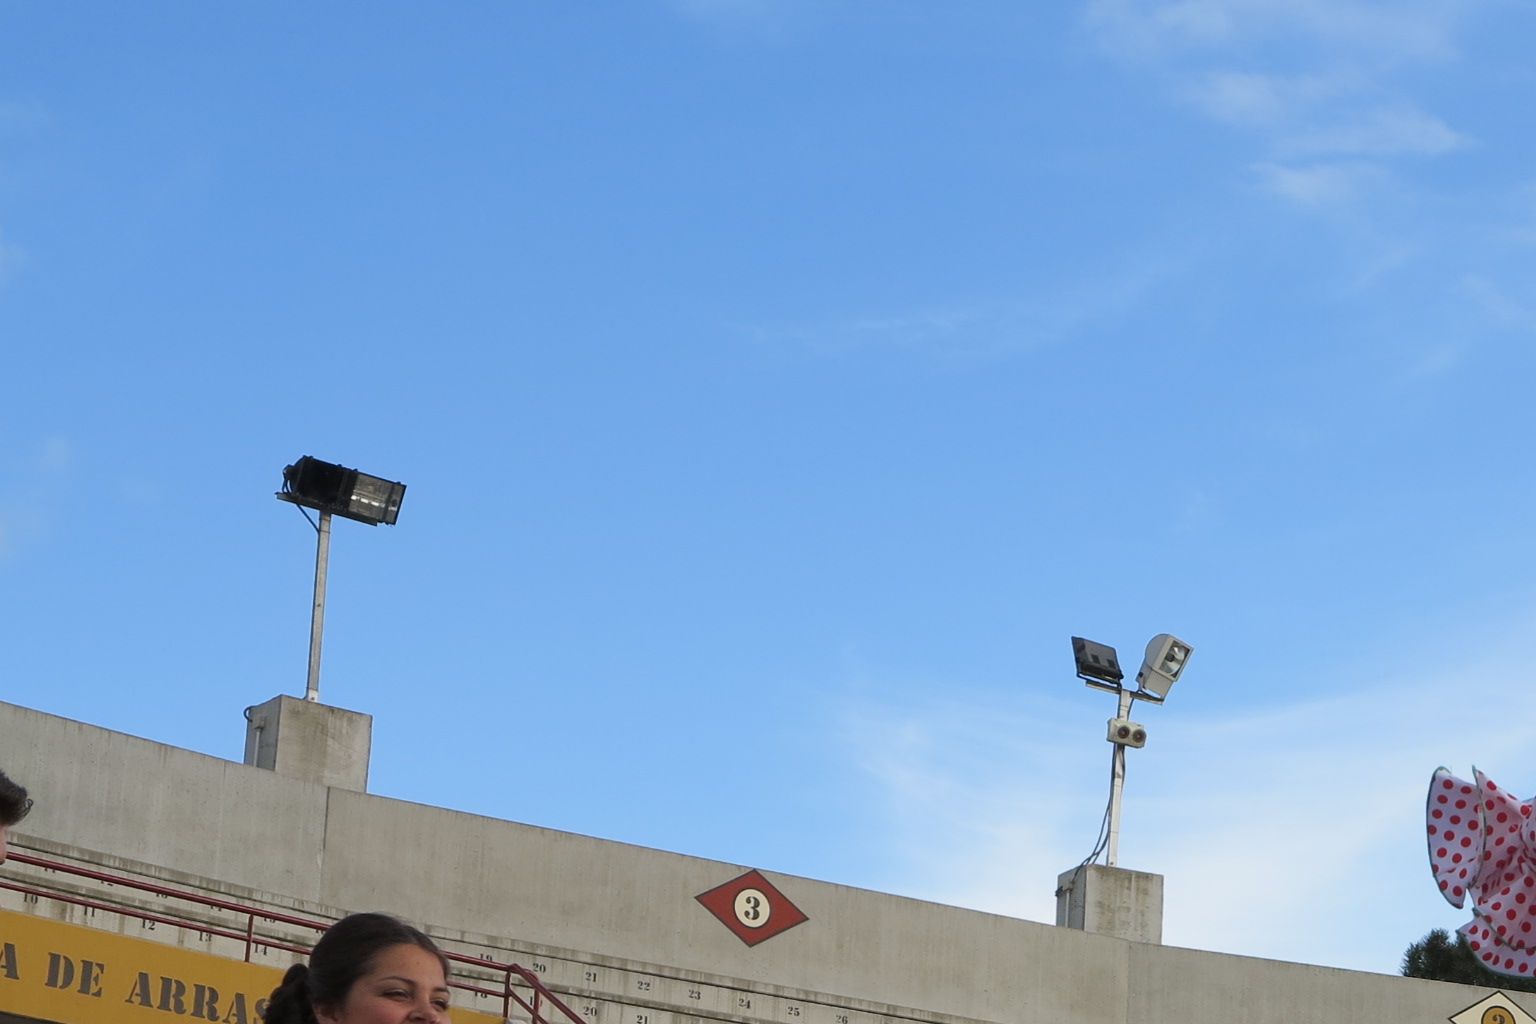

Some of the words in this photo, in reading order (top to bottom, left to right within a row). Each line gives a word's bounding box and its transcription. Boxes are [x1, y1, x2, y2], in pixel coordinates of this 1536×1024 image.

[744, 896, 760, 920] 3
[142, 919, 155, 930] 12
[532, 963, 546, 974] 20
[45, 952, 104, 998] DE
[585, 972, 597, 983] 21
[637, 981, 650, 991] 22
[688, 989, 701, 1000] 23
[739, 999, 751, 1009] 24
[583, 1006, 597, 1017] 20
[787, 1006, 800, 1017] 25
[835, 1014, 848, 1024] 26
